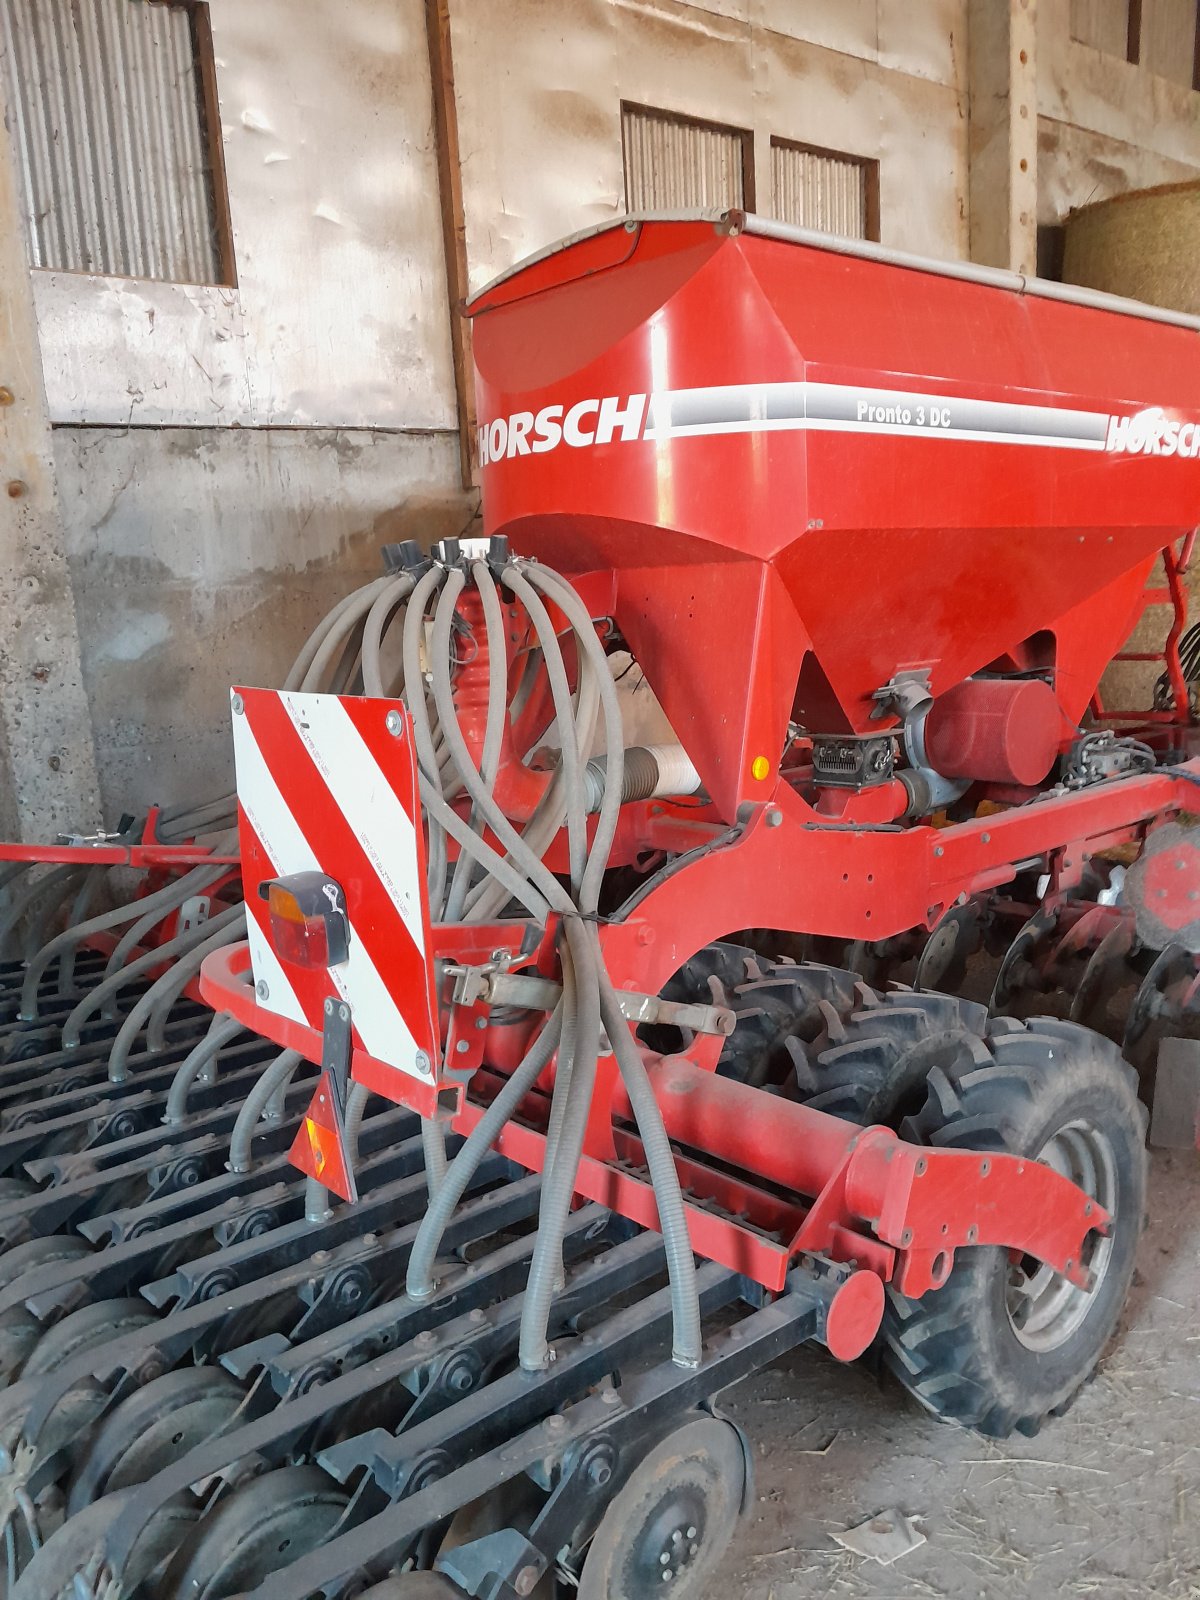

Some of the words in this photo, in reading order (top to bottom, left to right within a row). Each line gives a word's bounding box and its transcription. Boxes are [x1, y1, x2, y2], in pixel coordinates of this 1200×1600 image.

[479, 393, 646, 467] HORSCH
[857, 400, 911, 424] Pronto
[916, 406, 925, 425] 3
[930, 407, 951, 427] DC
